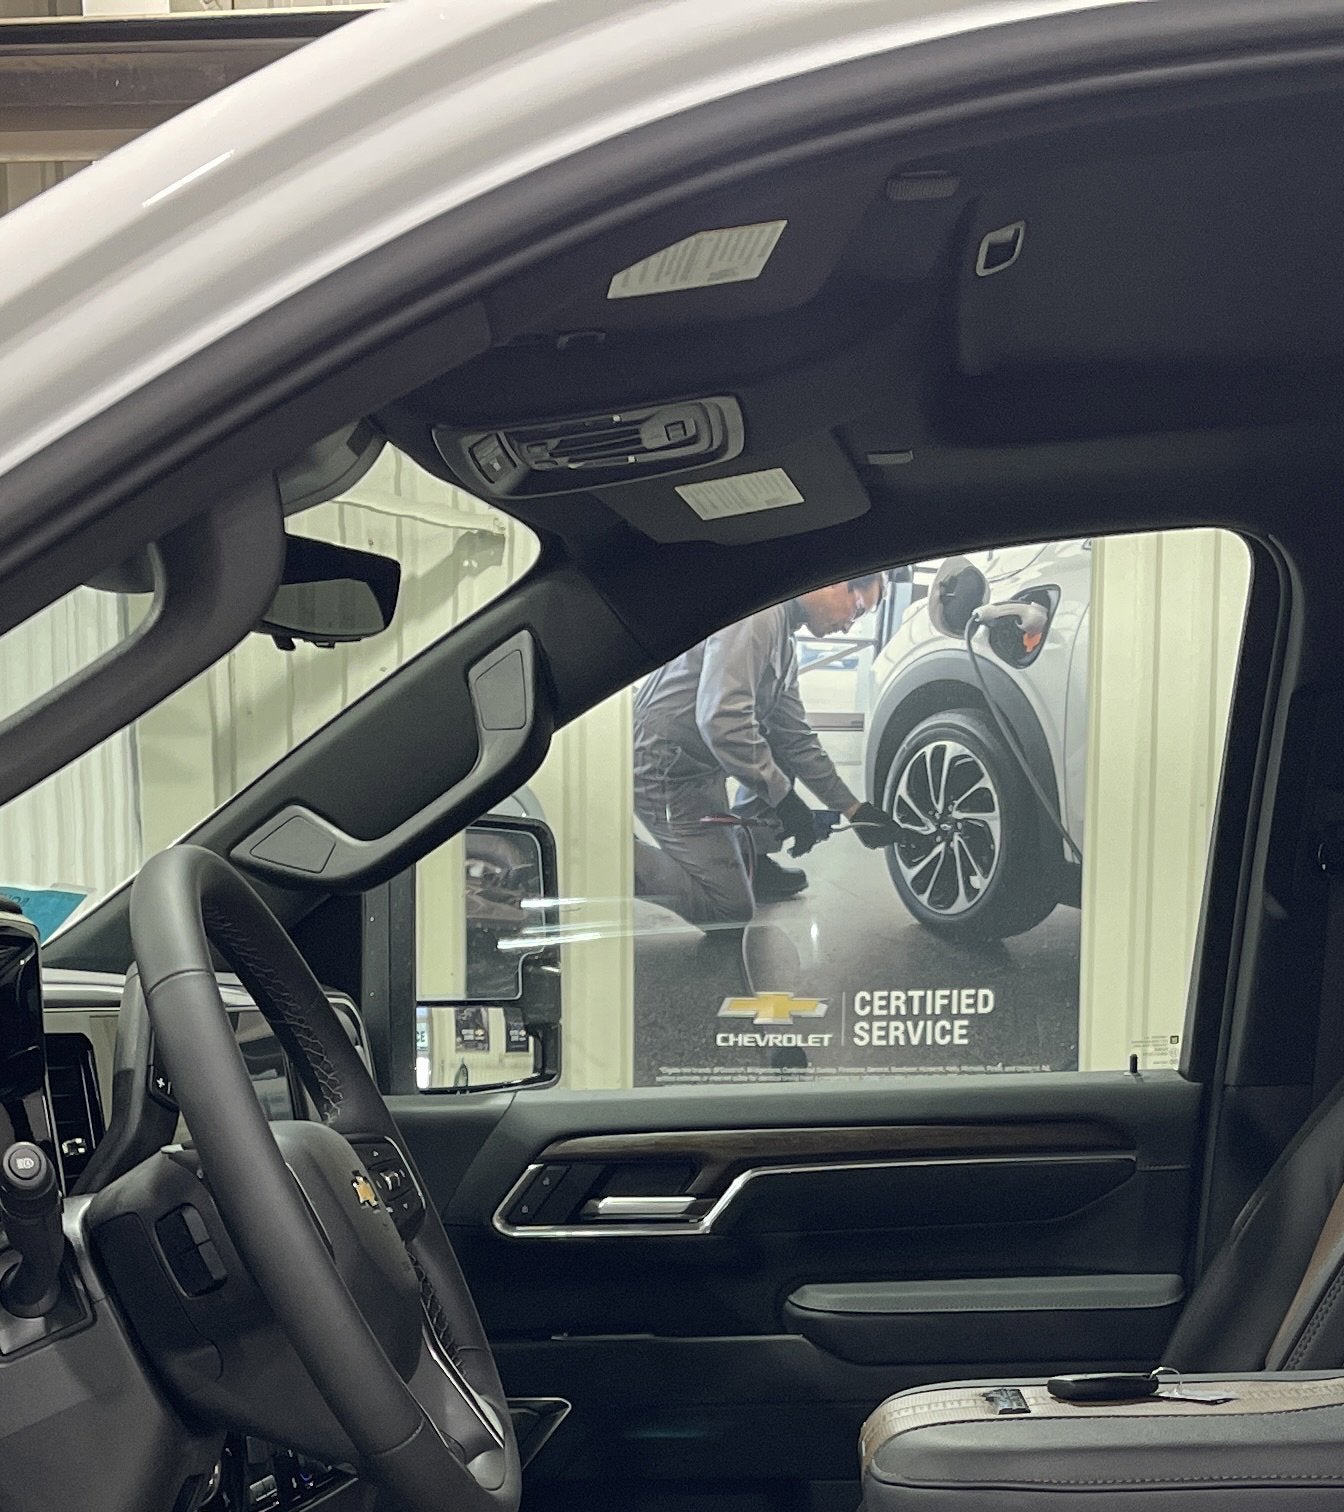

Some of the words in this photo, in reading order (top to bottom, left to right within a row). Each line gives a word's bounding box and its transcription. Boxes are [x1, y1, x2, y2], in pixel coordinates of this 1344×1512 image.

[854, 989, 995, 1016] CERTIFIED
[716, 1033, 833, 1047] CHEVROLET
[853, 1020, 969, 1046] SERVICE
